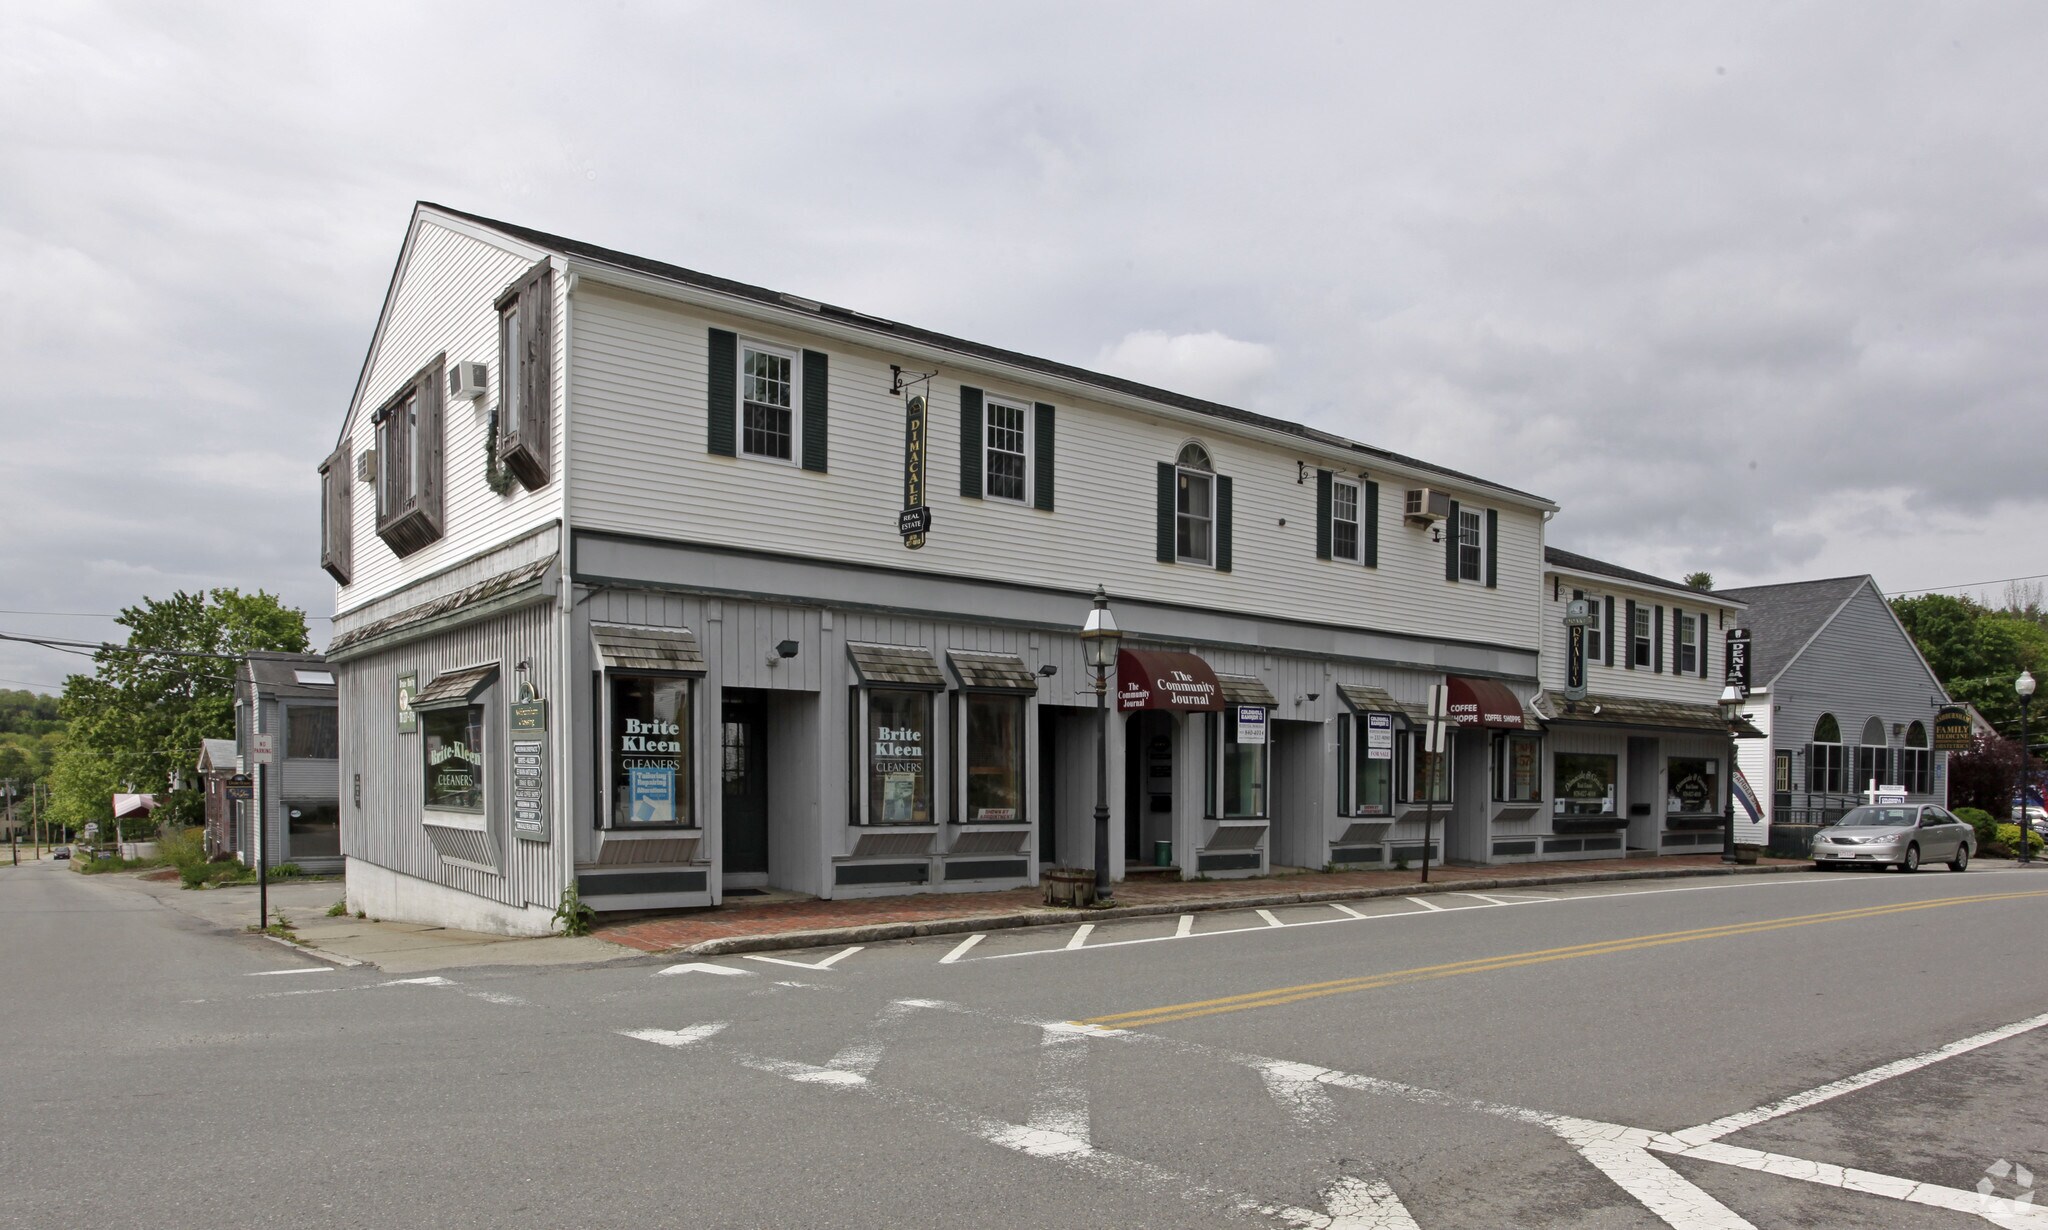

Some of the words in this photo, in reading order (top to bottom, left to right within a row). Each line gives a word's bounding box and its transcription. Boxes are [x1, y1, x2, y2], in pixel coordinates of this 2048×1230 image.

[909, 419, 920, 505] DIMACALE
[903, 513, 919, 521] REAL
[901, 521, 921, 530] ESTATE
[1573, 626, 1582, 686] REALTY
[1171, 671, 1193, 682] The
[1128, 683, 1139, 691] The
[1157, 679, 1215, 695] Community
[1118, 690, 1150, 699] Community
[1171, 692, 1209, 705] Journal
[1123, 699, 1145, 708] Journal
[1450, 704, 1477, 712] COFFEE
[1452, 714, 1478, 722] HOPPE
[1484, 713, 1502, 722] COFFEE
[1503, 715, 1521, 723] SHOPPE
[625, 718, 680, 735] Brite
[878, 727, 921, 741] Brite
[621, 735, 681, 752] Kleen
[875, 742, 923, 756] Kleen
[431, 741, 482, 766] Brite-Kleen
[622, 759, 680, 770] CLEANERS
[876, 762, 922, 772] CLEANERS
[438, 774, 473, 786] CLEANERS
[637, 772, 667, 780] Tailoring
[637, 779, 667, 787] Repairing
[1733, 772, 1752, 798] BARBER
